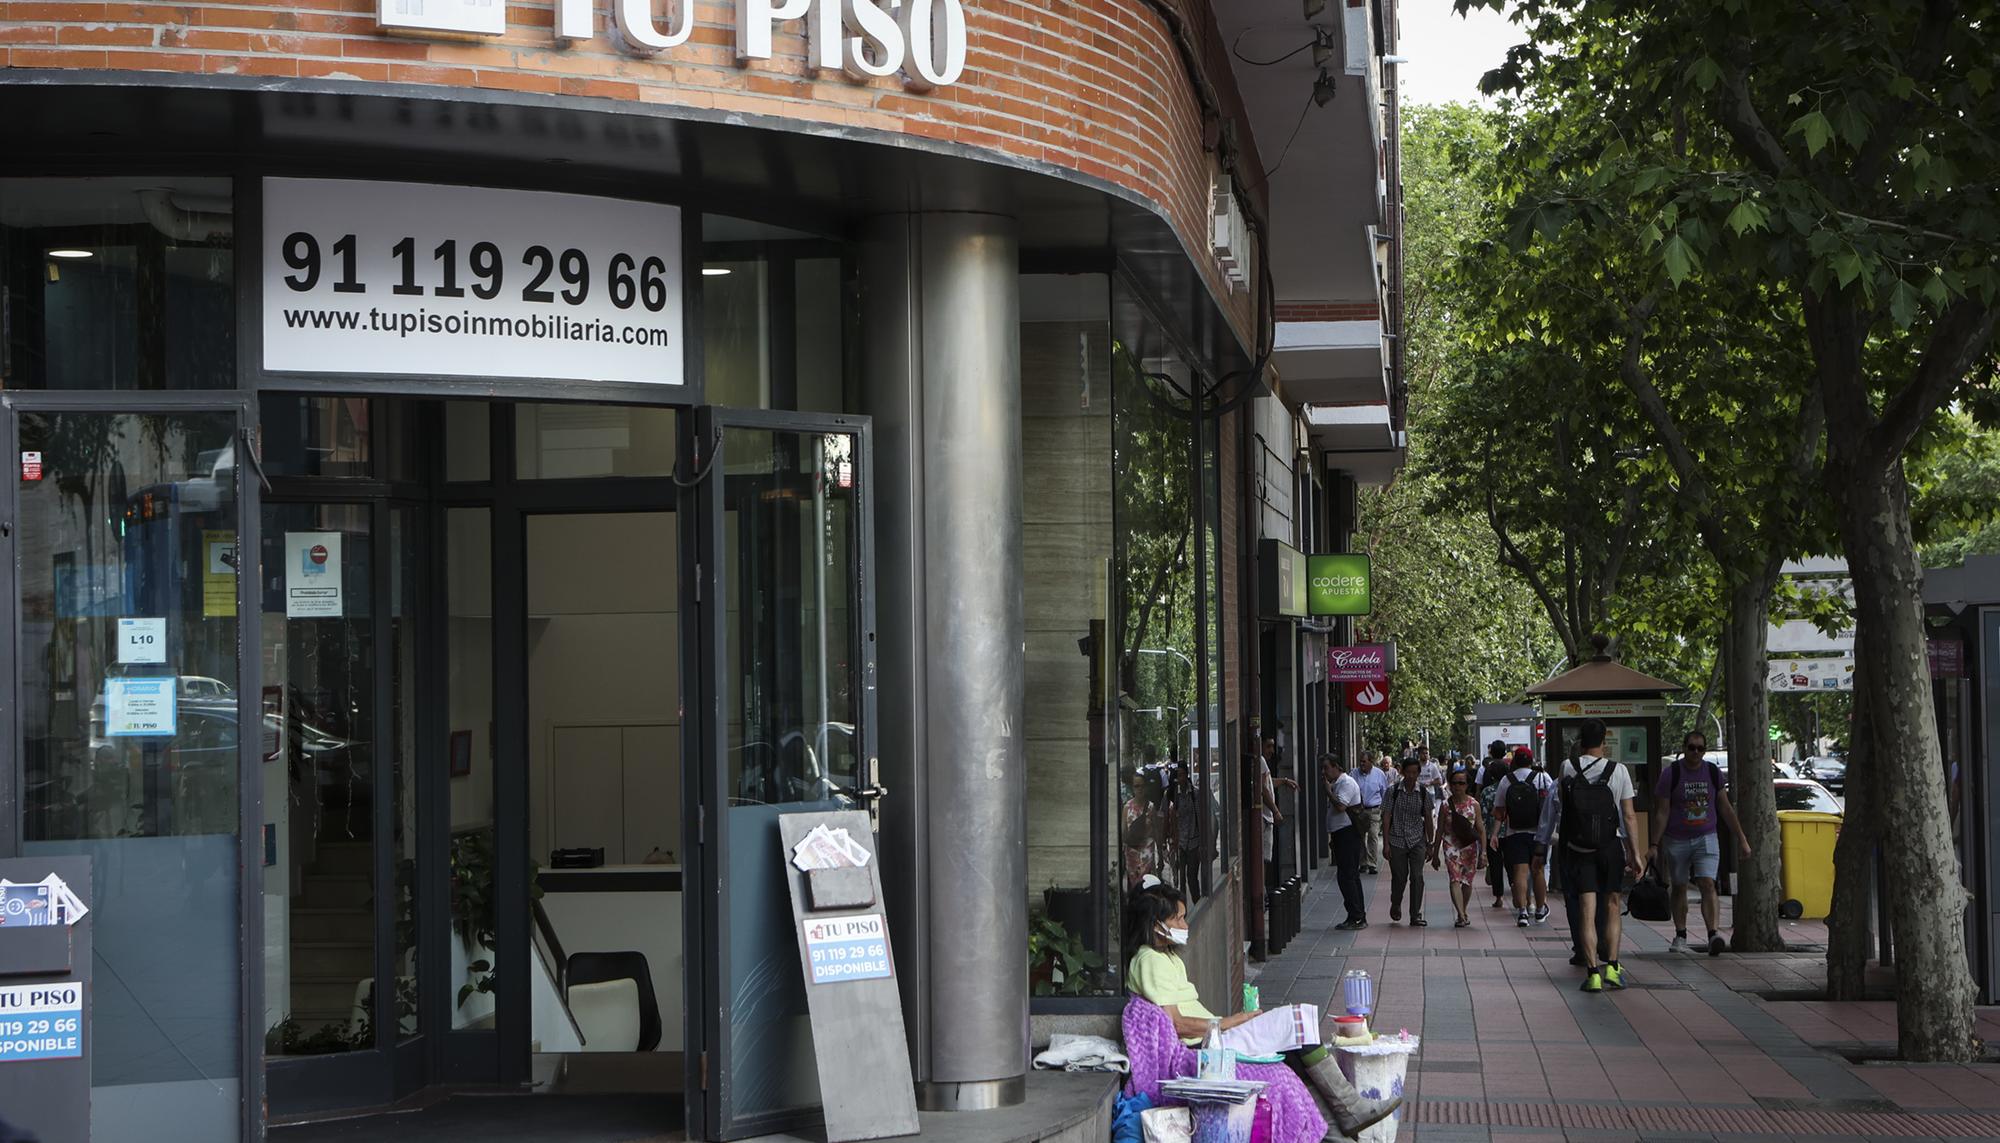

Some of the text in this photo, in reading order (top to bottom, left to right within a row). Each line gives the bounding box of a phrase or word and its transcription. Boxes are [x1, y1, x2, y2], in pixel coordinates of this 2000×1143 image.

[737, 0, 967, 86] PISO
[281, 231, 668, 313] 91 119 29 66
[283, 307, 669, 347] www.tupisoinmobiliaria.com
[1312, 574, 1365, 587] codere
[1321, 587, 1366, 596] APUESTAS
[131, 635, 154, 644] L10
[1331, 650, 1381, 669] Castela
[824, 920, 879, 937] TU PISO
[812, 944, 884, 961] 91 119 29 66
[815, 960, 887, 977] DISPONIBLE
[0, 989, 76, 1007] TU PISO
[28, 1020, 50, 1034] 29
[54, 1018, 77, 1032] 66
